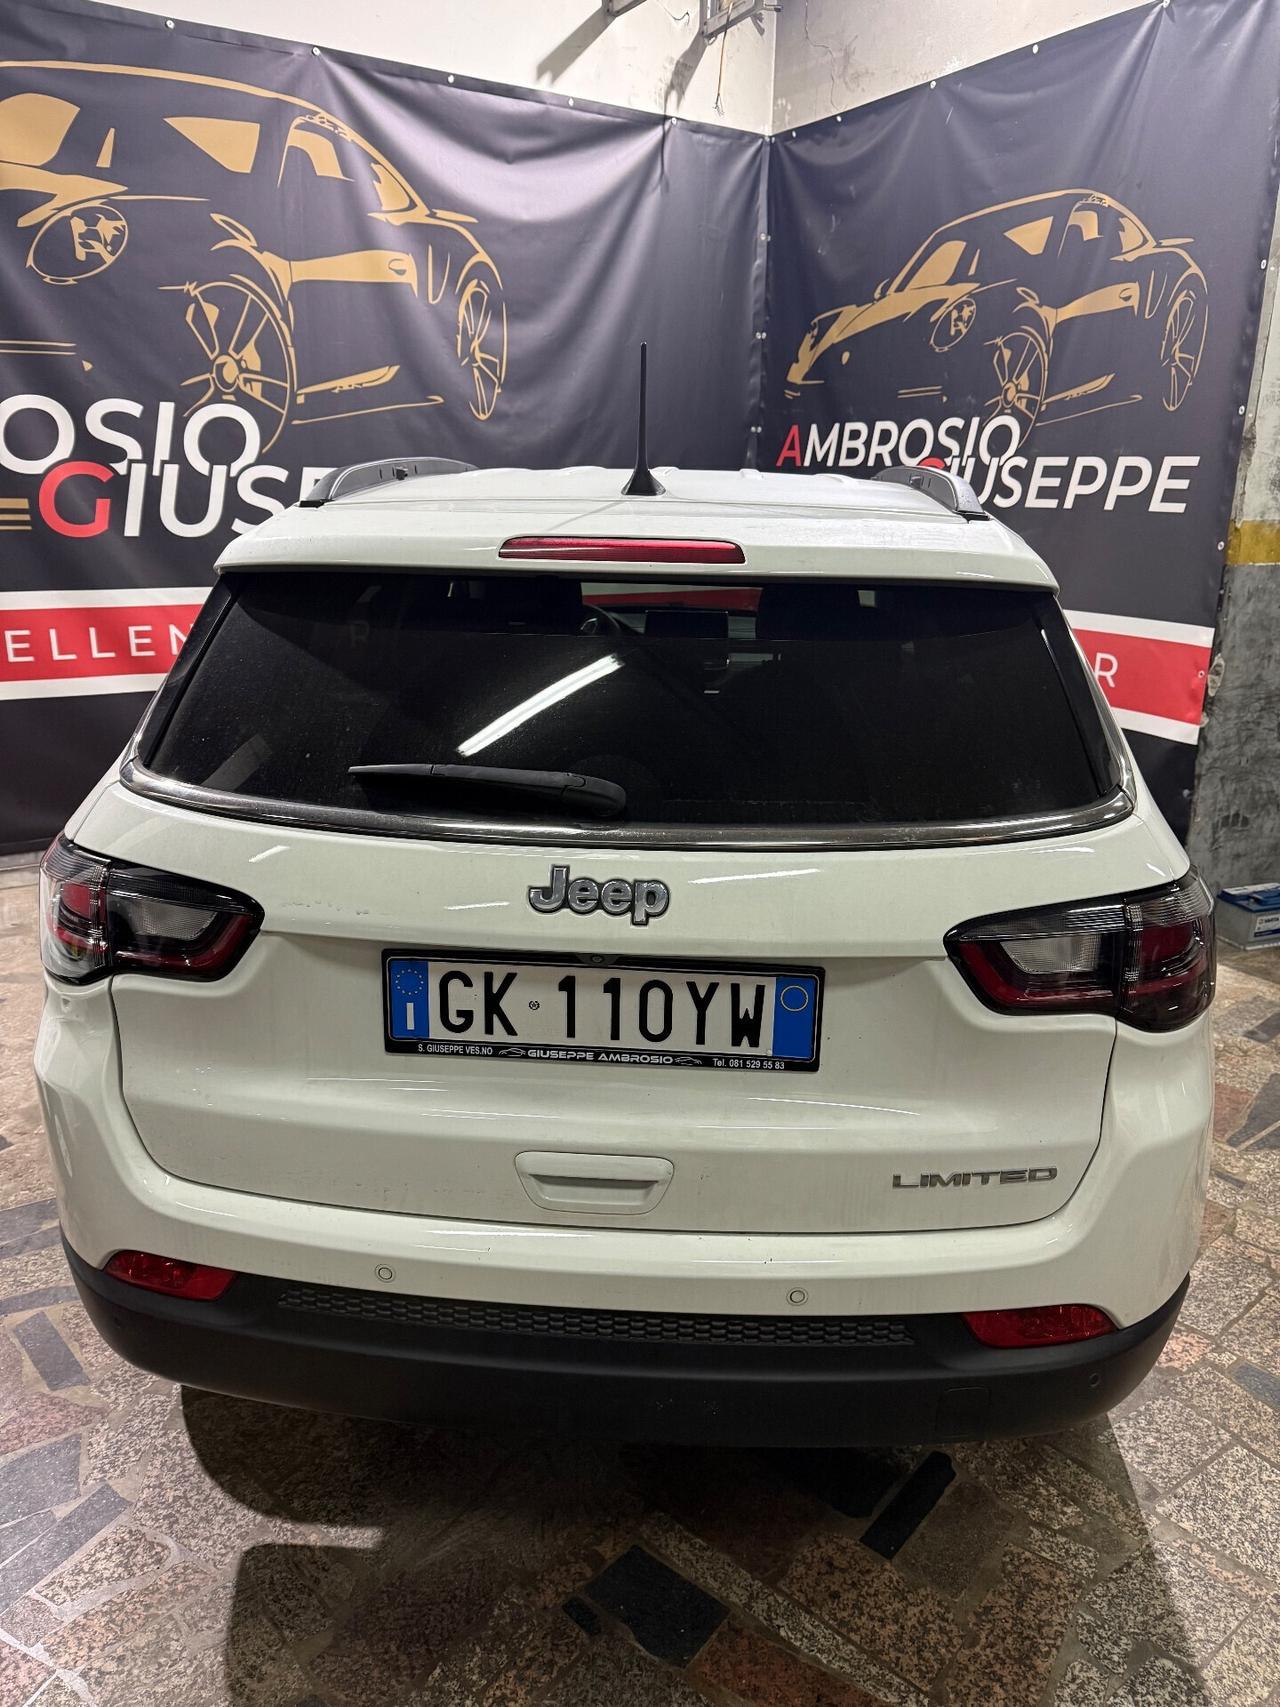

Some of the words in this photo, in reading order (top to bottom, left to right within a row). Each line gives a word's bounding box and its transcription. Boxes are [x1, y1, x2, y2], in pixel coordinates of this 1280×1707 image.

[0, 394, 261, 477] OSIO
[776, 414, 1020, 467] AMBROSIO
[38, 460, 334, 538] GIUS
[917, 456, 1200, 513] USEPPE
[528, 864, 670, 926] Jeep
[439, 970, 518, 1036] GK
[558, 975, 765, 1048] 110YW
[426, 1044, 464, 1055] GIUSEPPE
[465, 1045, 493, 1055] VES.NO
[527, 1049, 594, 1060] GIUSEPPE
[597, 1052, 674, 1064] AMBROSIO
[713, 1058, 727, 1067] Tel.
[729, 1059, 744, 1068] 081
[746, 1060, 761, 1069] 529
[762, 1061, 773, 1069] 55
[774, 1061, 785, 1070] 83
[892, 1167, 1057, 1189] LIMITED
